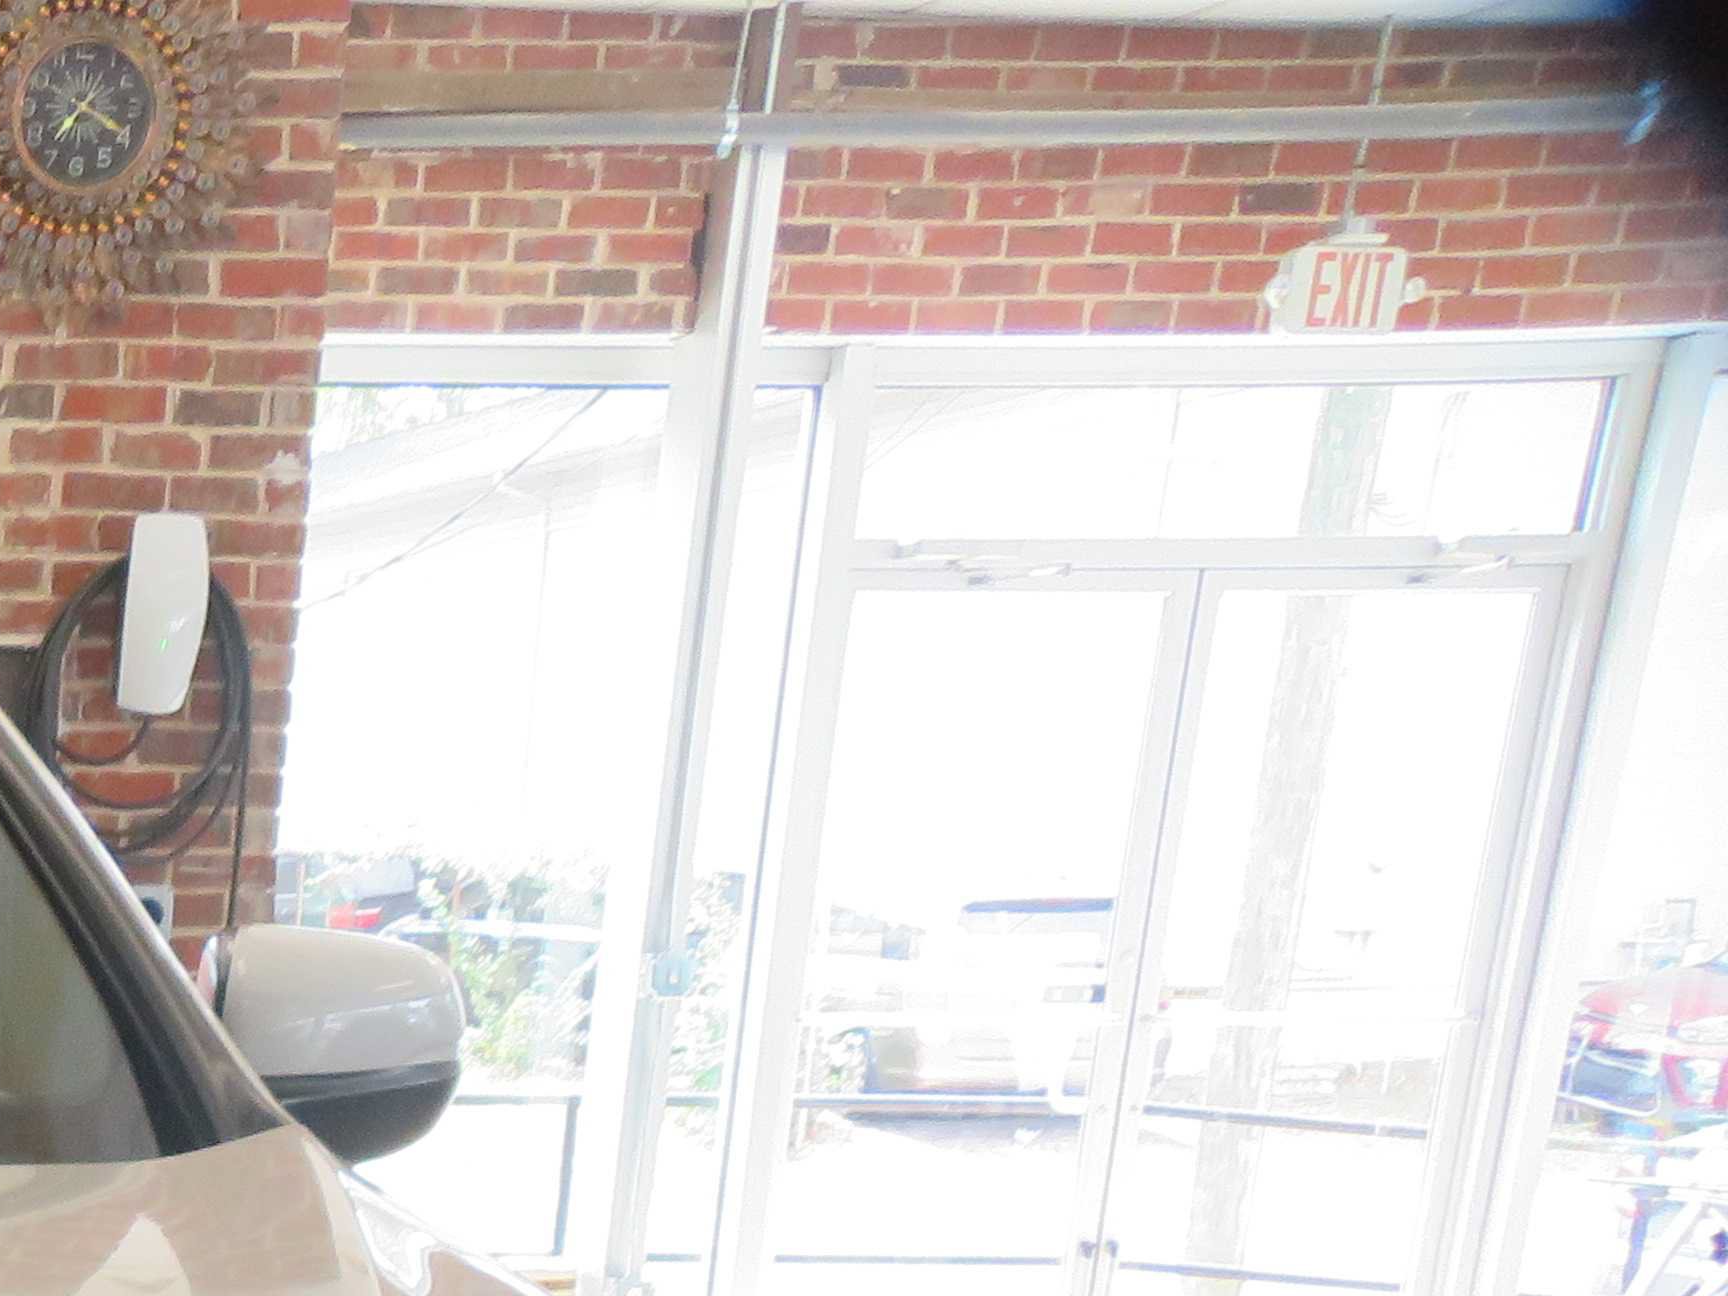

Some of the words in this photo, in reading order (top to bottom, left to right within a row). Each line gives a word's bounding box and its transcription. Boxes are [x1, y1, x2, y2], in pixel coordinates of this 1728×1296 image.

[115, 123, 132, 150] 4
[44, 149, 58, 169] 7
[68, 156, 84, 177] 6
[96, 146, 112, 168] 5
[1305, 250, 1395, 328] EXIT
